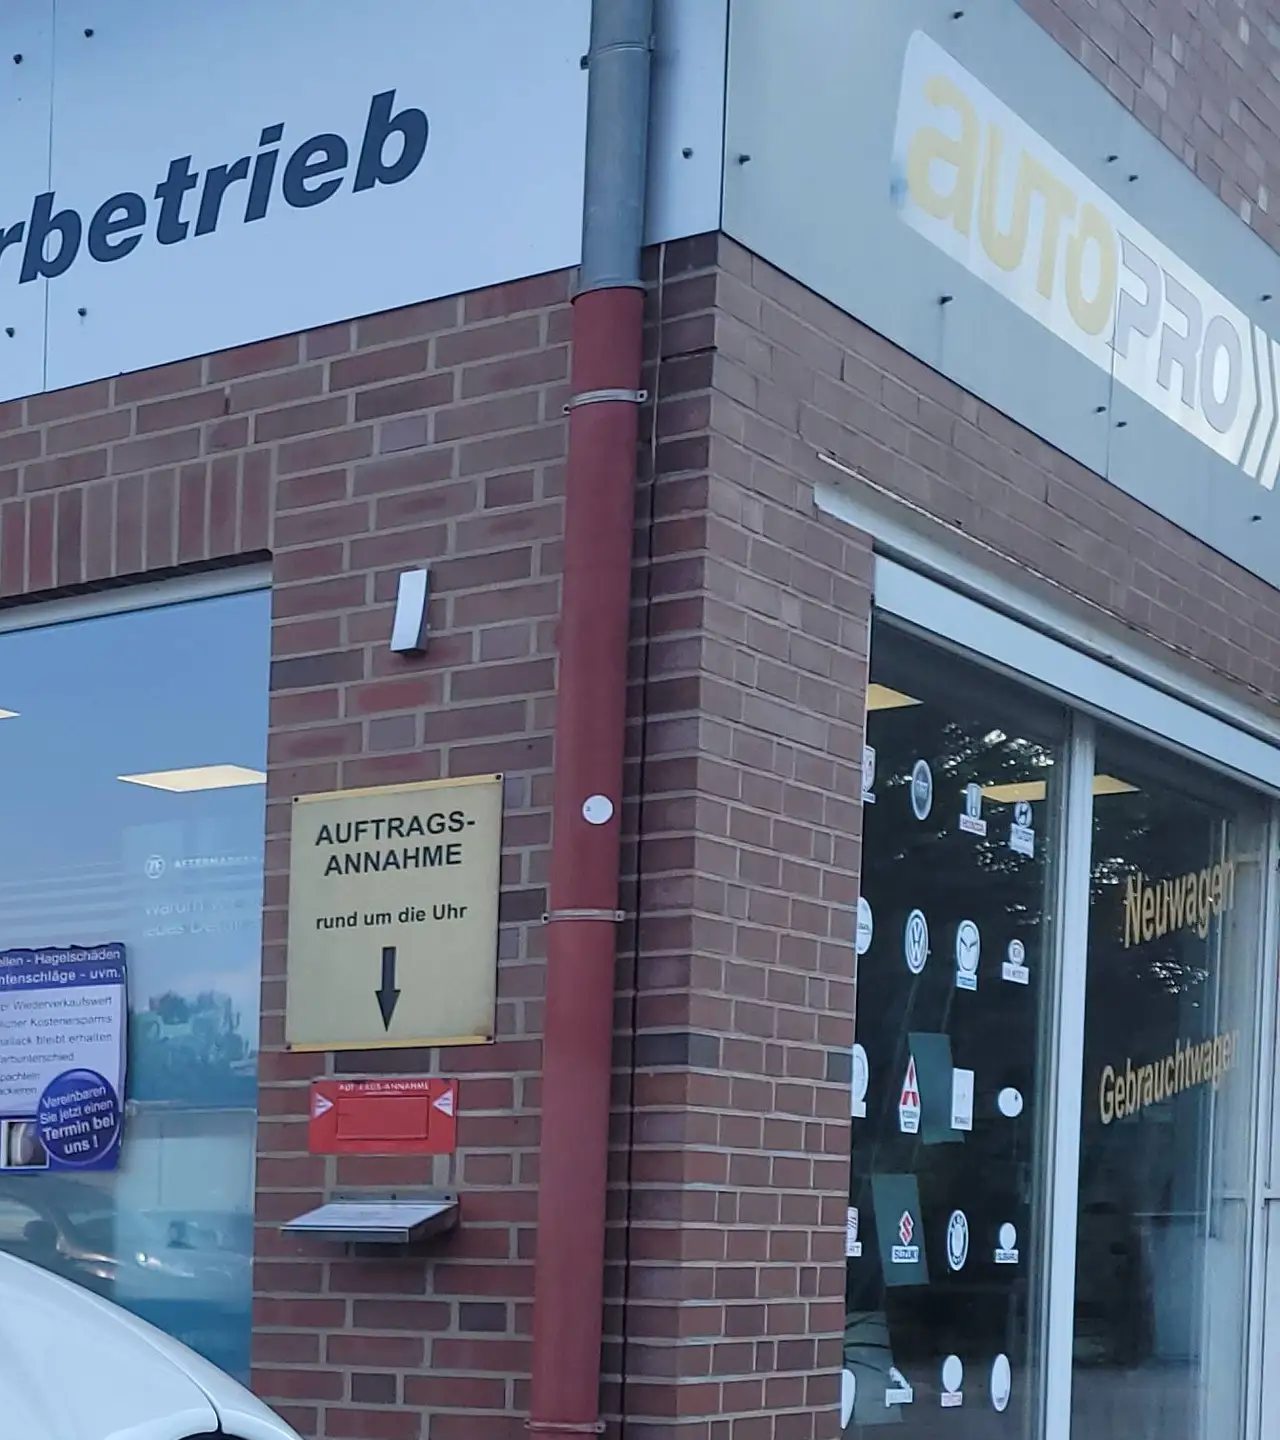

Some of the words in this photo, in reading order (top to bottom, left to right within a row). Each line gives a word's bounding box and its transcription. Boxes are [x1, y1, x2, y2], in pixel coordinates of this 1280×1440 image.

[315, 811, 476, 846] AUFTRAGS-
[324, 843, 462, 876] ANNAHME
[316, 911, 358, 930] rund
[364, 912, 391, 926] um
[398, 907, 426, 923] die
[433, 903, 468, 920] Uhr
[1124, 860, 1235, 949] Neuwagen
[34, 949, 121, 966] Hagelschäden
[90, 967, 121, 981] uvm.
[1099, 1030, 1239, 1127] Gebrauchtwagen
[42, 1085, 106, 1109] Vereinbaren
[40, 1112, 57, 1125] Sie
[59, 1105, 82, 1123] jetzt
[84, 1099, 113, 1114] einen
[43, 1121, 90, 1141] Termin
[92, 1113, 115, 1130] bei
[64, 1138, 90, 1155] uns
